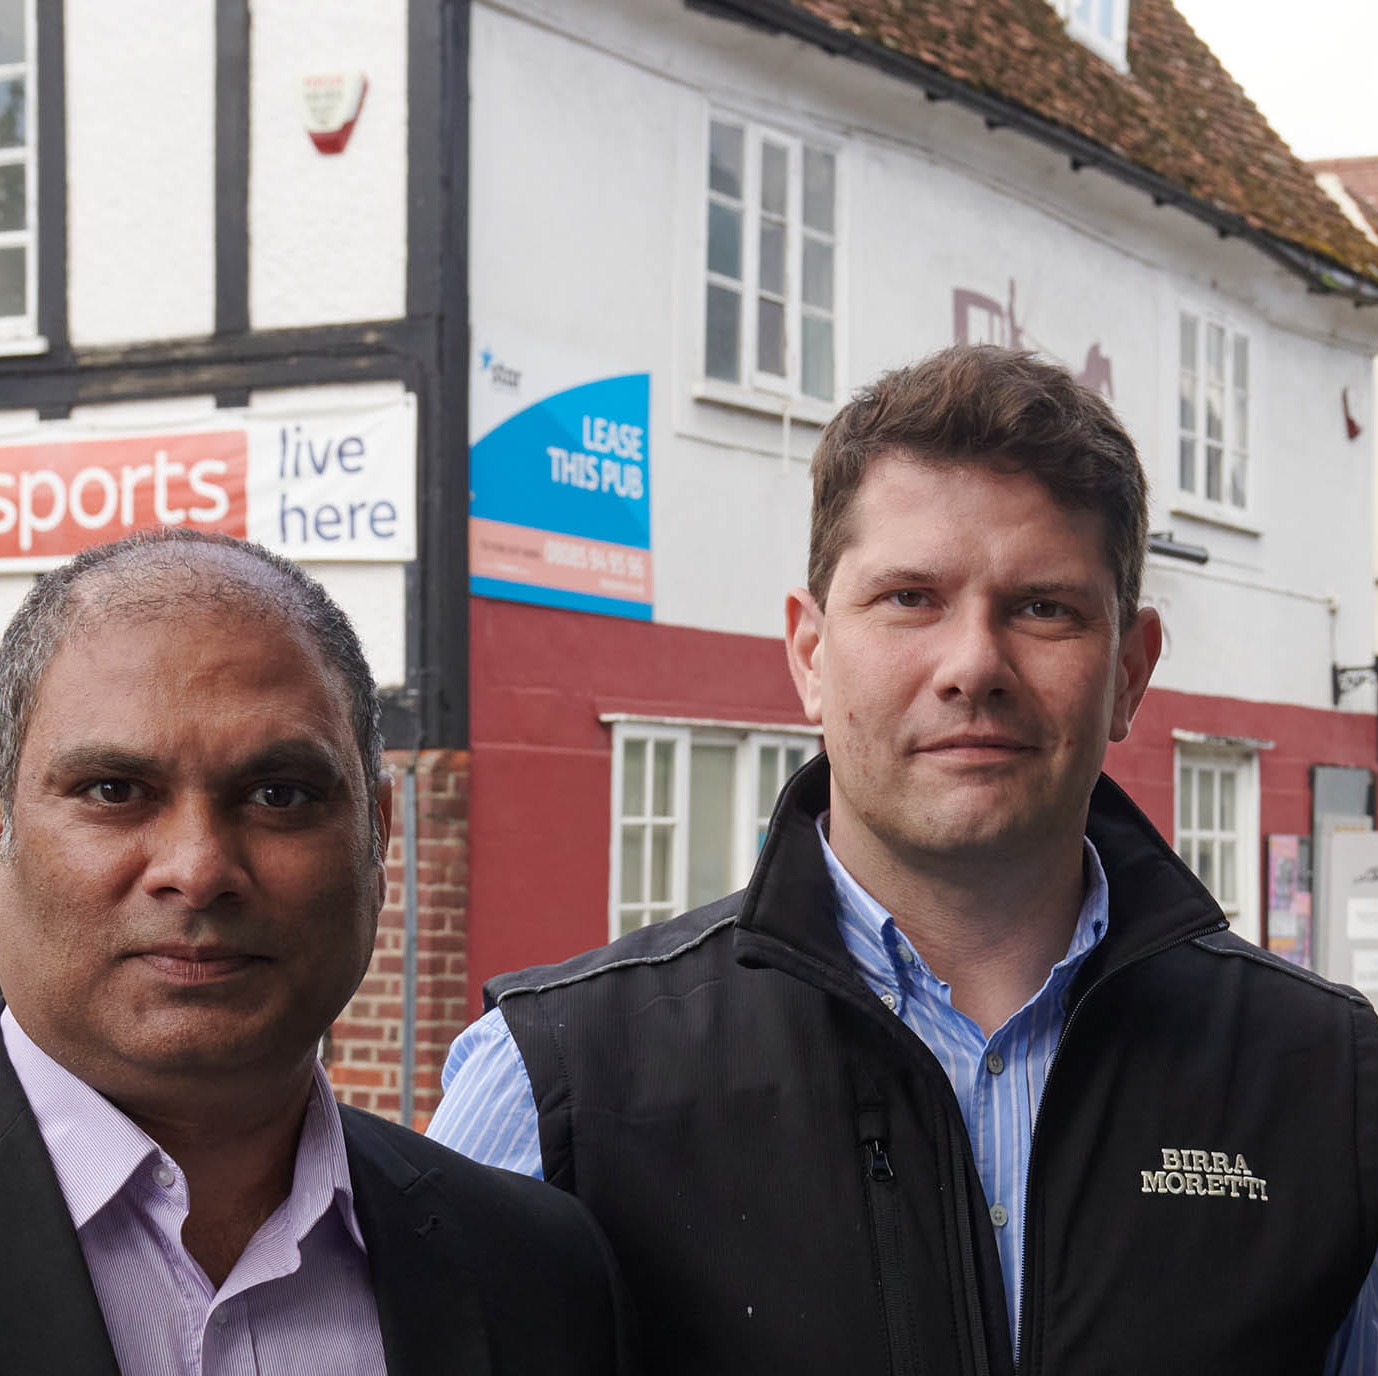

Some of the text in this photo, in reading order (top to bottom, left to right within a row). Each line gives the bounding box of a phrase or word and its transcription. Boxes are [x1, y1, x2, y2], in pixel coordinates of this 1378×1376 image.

[279, 426, 365, 479] live
[582, 414, 644, 462] LEASE
[546, 446, 644, 500] THIS PUB
[280, 493, 398, 543] here
[1140, 1171, 1269, 1201] MORETTI
[1161, 1148, 1253, 1175] BIRRA
